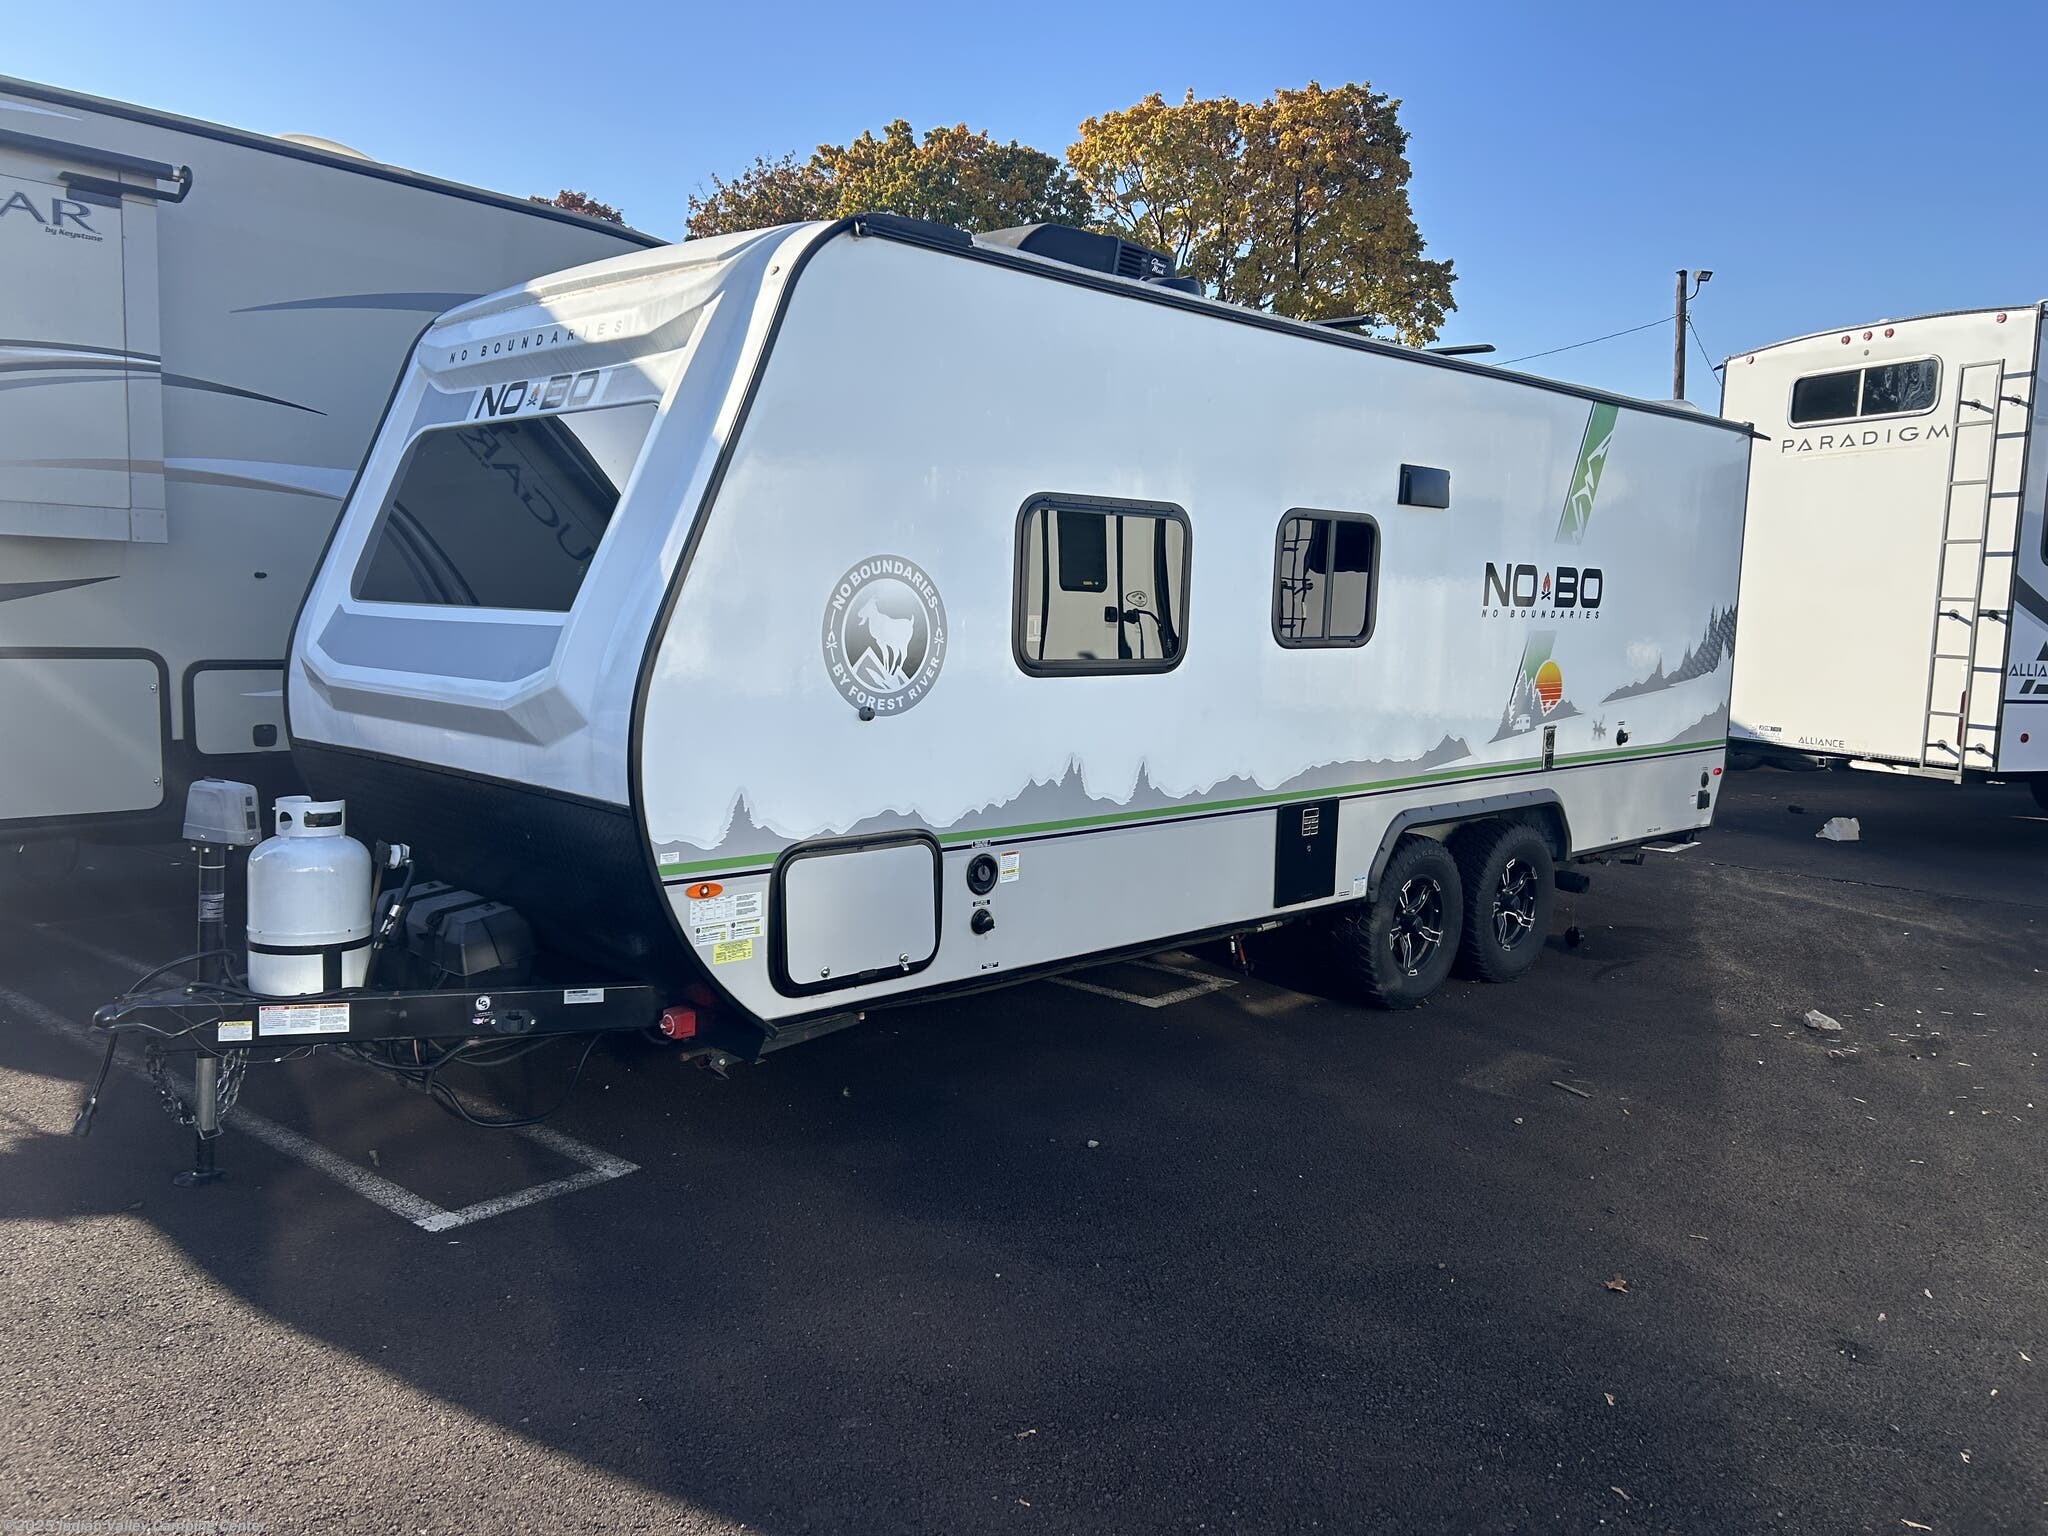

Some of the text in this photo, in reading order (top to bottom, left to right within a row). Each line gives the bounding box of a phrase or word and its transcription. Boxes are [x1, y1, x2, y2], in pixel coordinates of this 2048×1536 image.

[59, 229, 103, 242] Keystone
[450, 320, 623, 364] NO BOUNDARIES
[1781, 424, 1950, 453] PARADIGM
[832, 559, 938, 611] NO BOUNDARIES
[1481, 609, 1600, 619] NO BOUNDARIES
[832, 657, 939, 711] BY FOREST RIVER
[1798, 736, 1845, 749] ALLIANCE
